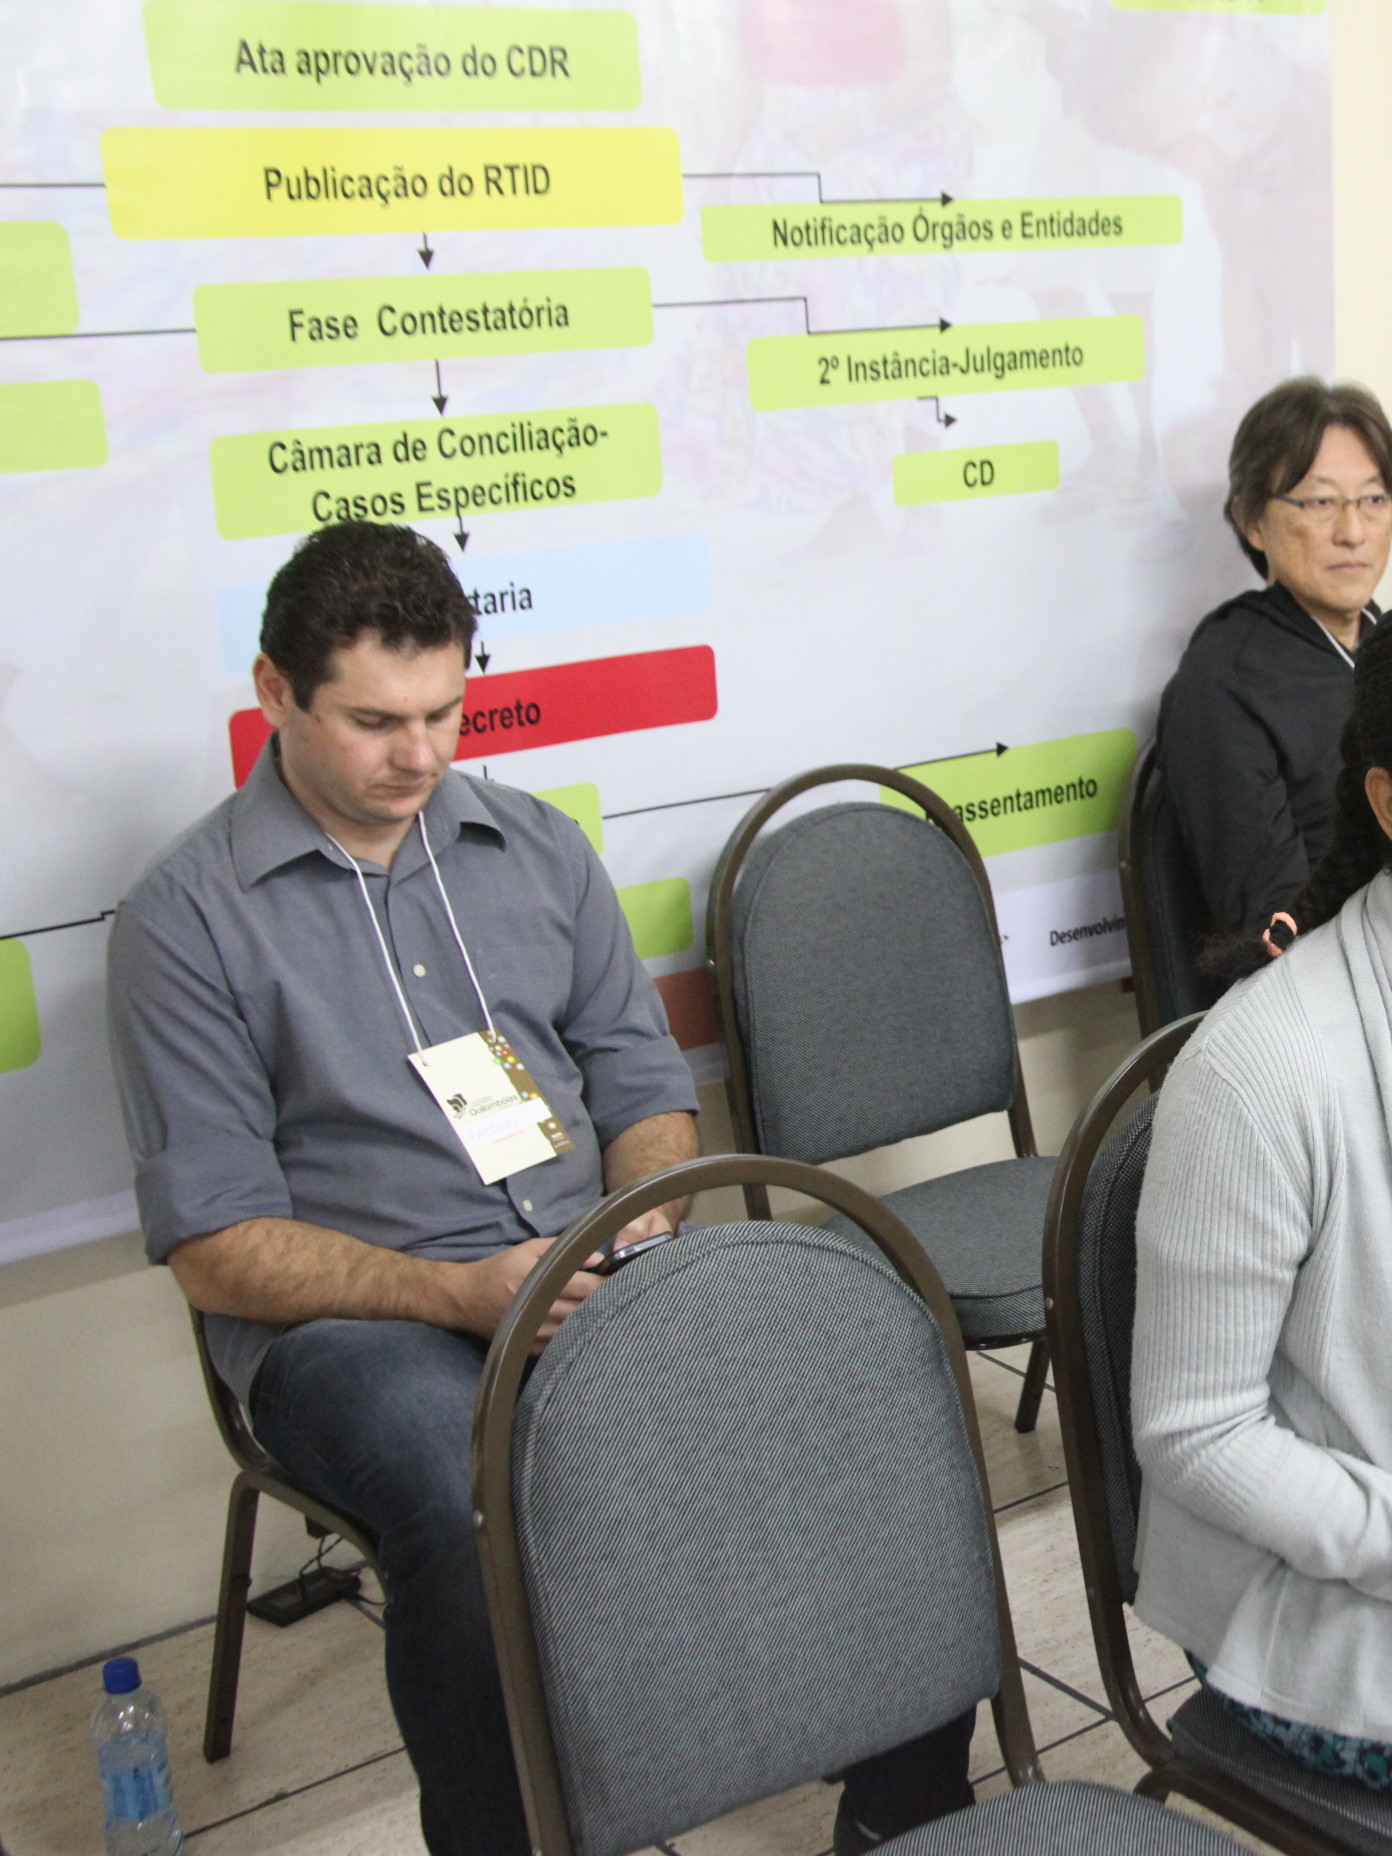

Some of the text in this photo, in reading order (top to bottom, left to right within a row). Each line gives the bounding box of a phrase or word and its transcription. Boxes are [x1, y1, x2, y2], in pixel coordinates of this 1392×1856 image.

[234, 38, 571, 85] Ata aprovação do CDR
[262, 163, 551, 207] Publicação do RTID
[771, 206, 1125, 252] Notificação Órgãos e Entidades
[287, 295, 571, 344] Fase Contestatória
[816, 342, 1085, 387] 2º Instância-Julgamento
[266, 416, 609, 477] Câmara de Conciliação-
[961, 457, 997, 489] CD
[311, 488, 407, 524] Casos
[467, 581, 533, 616] taria
[459, 698, 541, 736] ecreto
[952, 775, 1099, 823] assentamento
